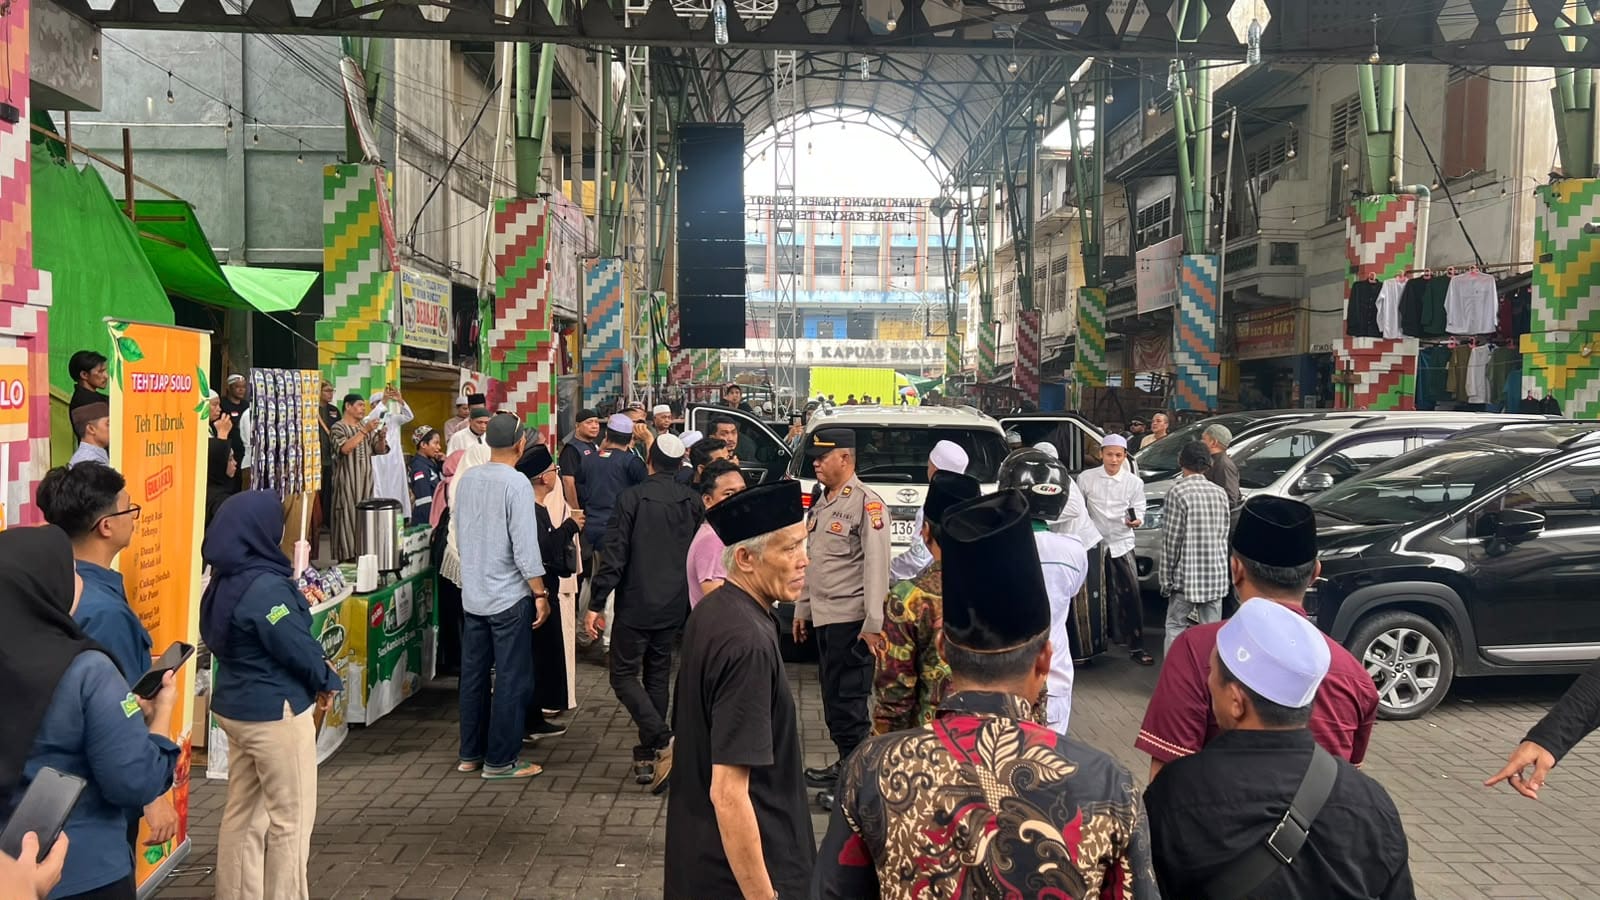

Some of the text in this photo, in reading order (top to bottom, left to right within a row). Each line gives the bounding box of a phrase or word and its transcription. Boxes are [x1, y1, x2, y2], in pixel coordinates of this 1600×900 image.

[821, 346, 884, 359] KAPUAS
[889, 347, 943, 359] BESAR
[132, 373, 192, 392] TEH TJAP SOLO
[135, 411, 185, 434] Teh Tubruk
[891, 521, 915, 536] 136
